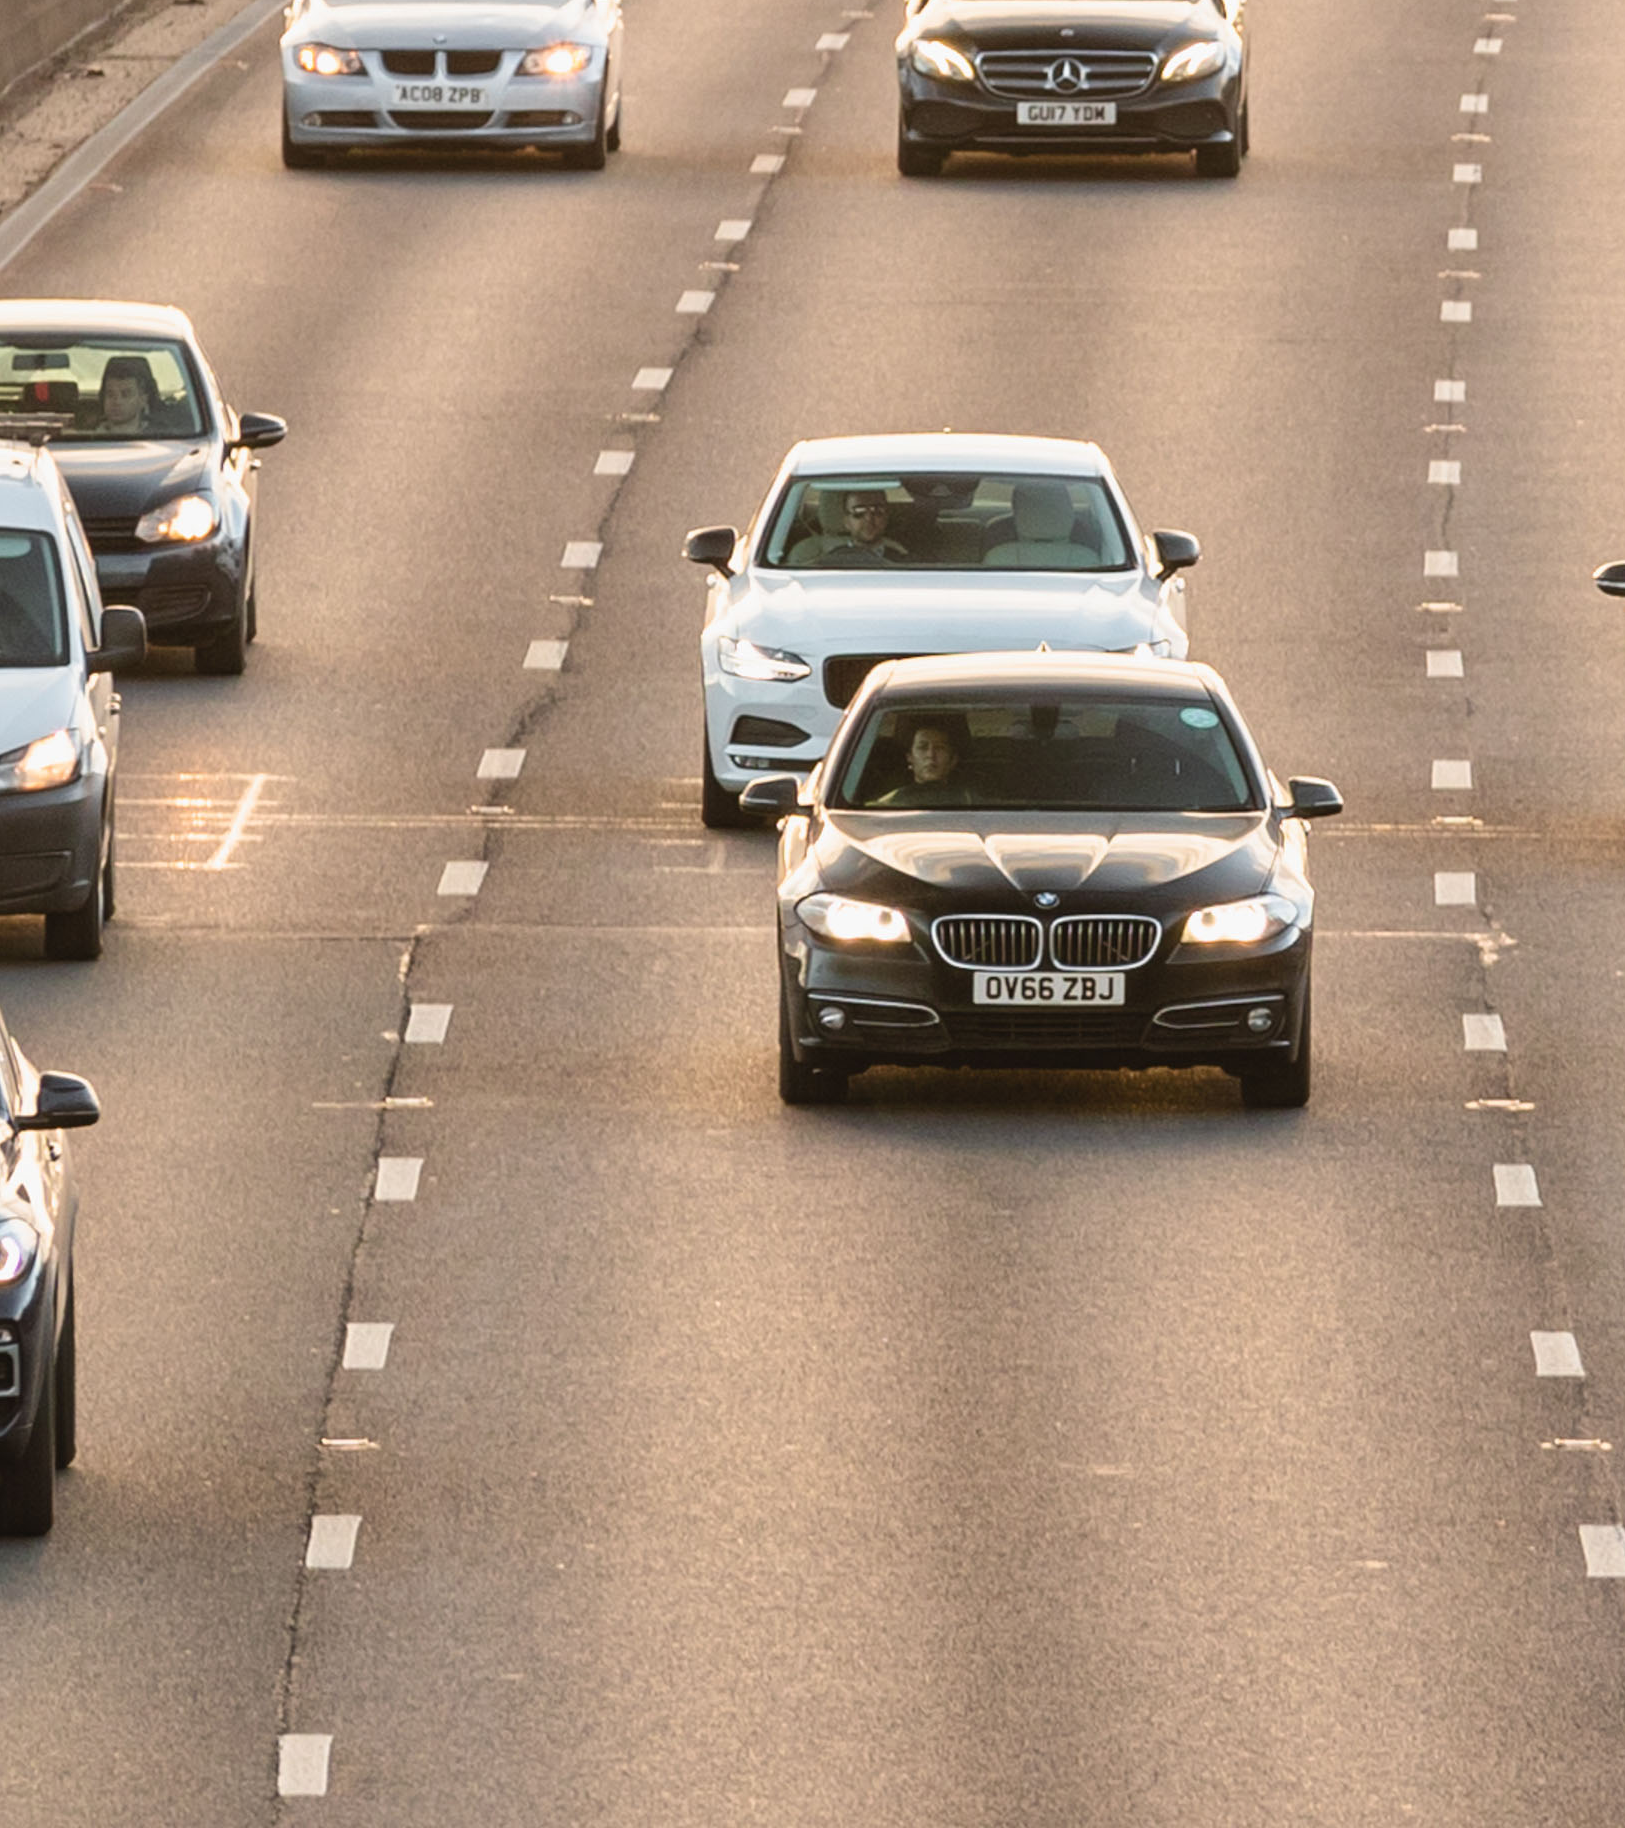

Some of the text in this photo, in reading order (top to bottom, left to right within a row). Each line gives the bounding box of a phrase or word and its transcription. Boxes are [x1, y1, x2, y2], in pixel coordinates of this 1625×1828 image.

[400, 85, 481, 103] AC08 ZPB
[1028, 106, 1068, 122] GU17
[985, 975, 1114, 1002] OV66 ZBJ
